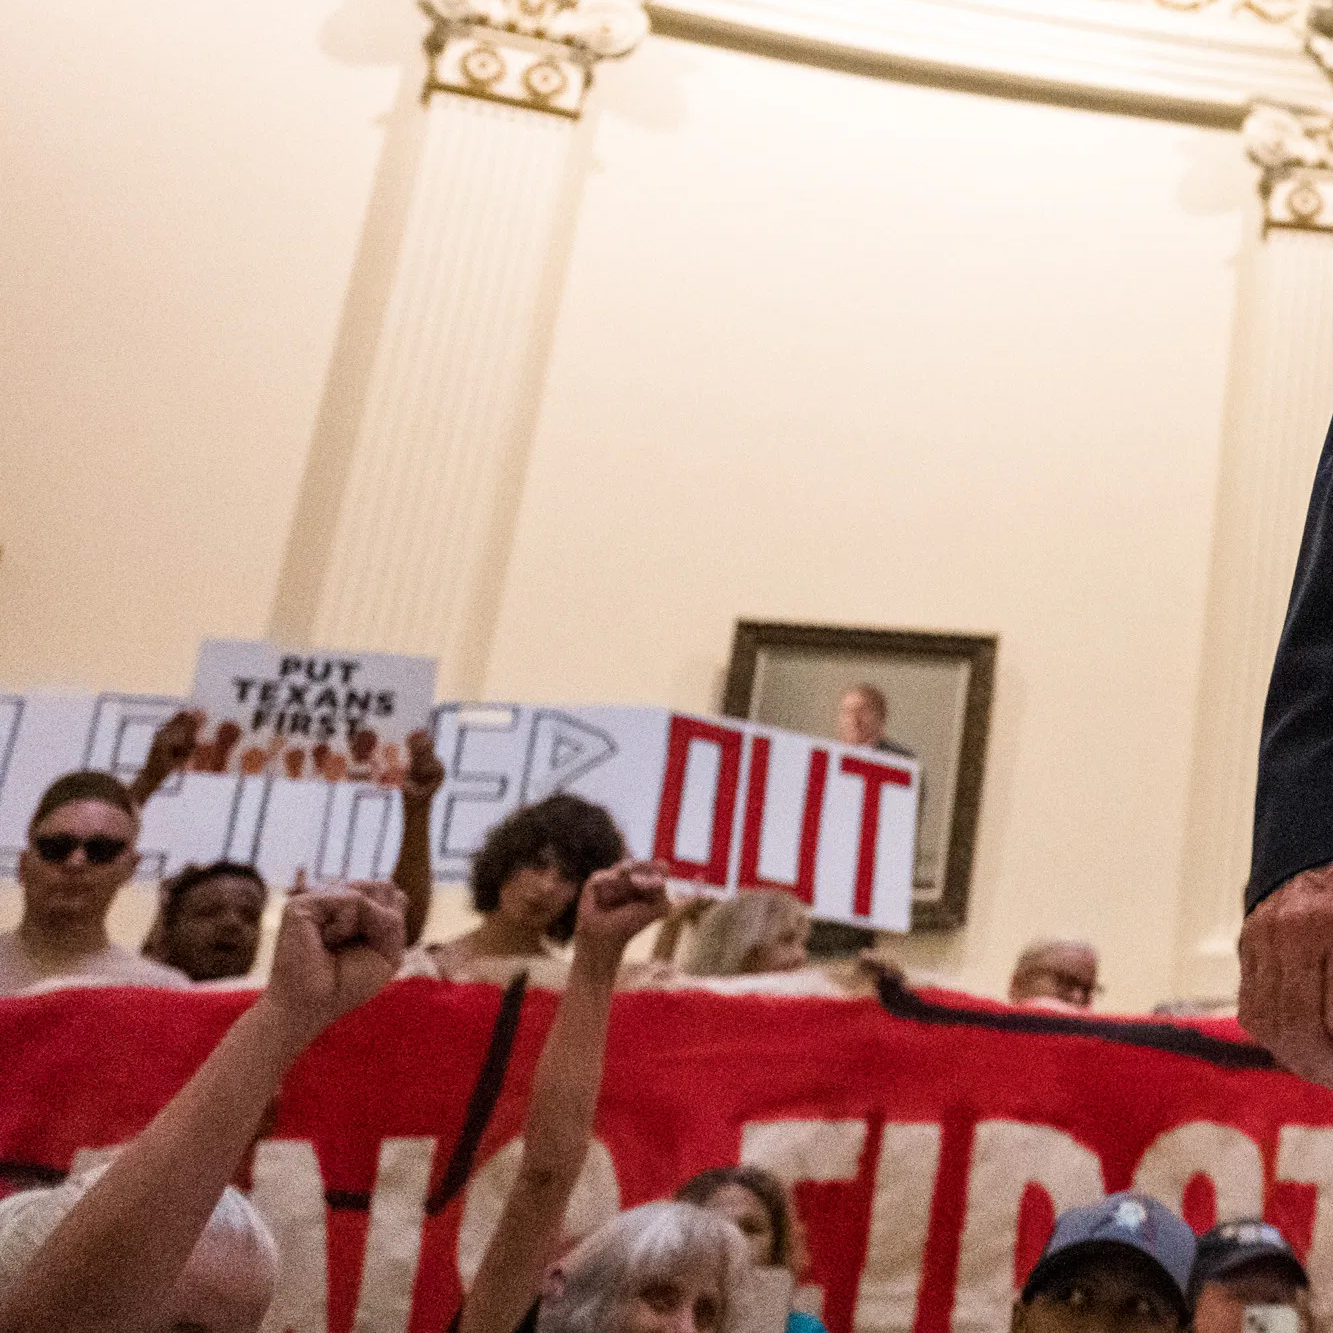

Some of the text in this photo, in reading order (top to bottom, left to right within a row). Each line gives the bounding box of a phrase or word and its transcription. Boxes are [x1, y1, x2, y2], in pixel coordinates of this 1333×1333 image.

[278, 654, 361, 684] PUT
[231, 676, 397, 717] TEXANS
[250, 708, 360, 739] FIRST
[653, 712, 912, 918] OUT
